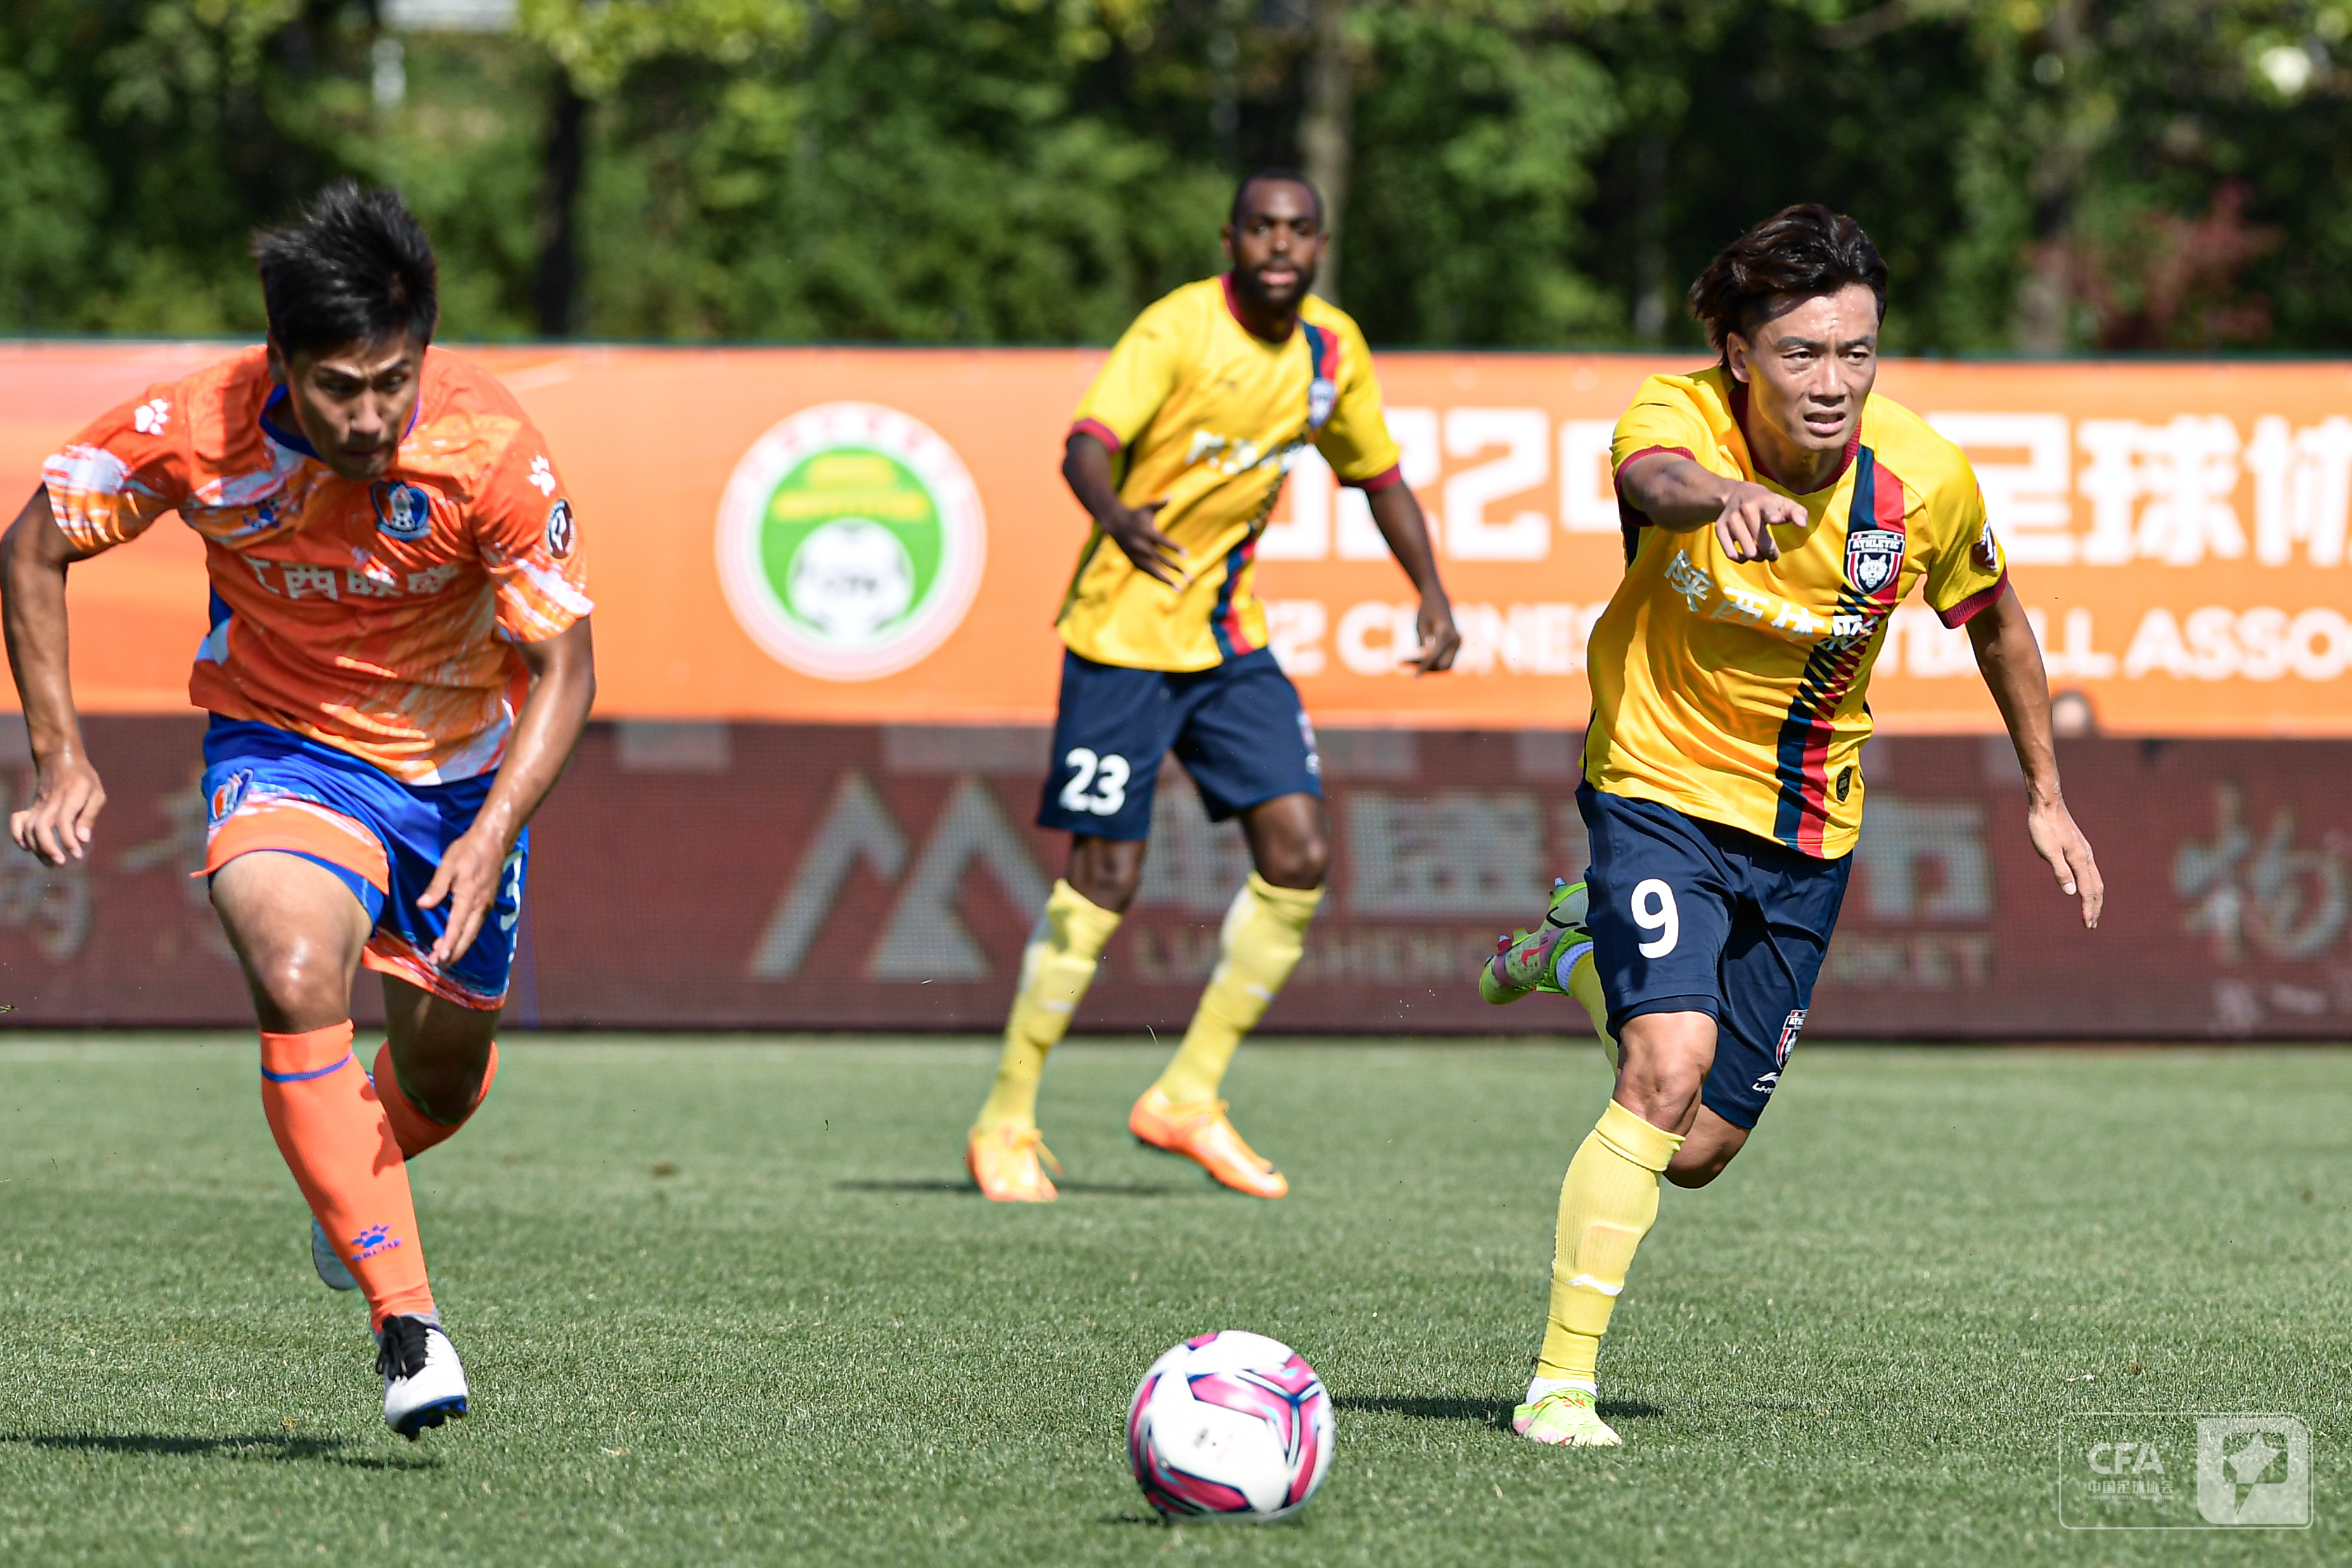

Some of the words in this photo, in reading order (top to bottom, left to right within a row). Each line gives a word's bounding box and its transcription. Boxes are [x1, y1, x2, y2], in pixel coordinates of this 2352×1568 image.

[1851, 539, 1900, 550] ATHLETIC
[1664, 549, 1879, 651] 陕西体彩
[2123, 606, 2352, 682] ASSO
[1058, 747, 1131, 817] 23
[1630, 879, 1680, 959] 9
